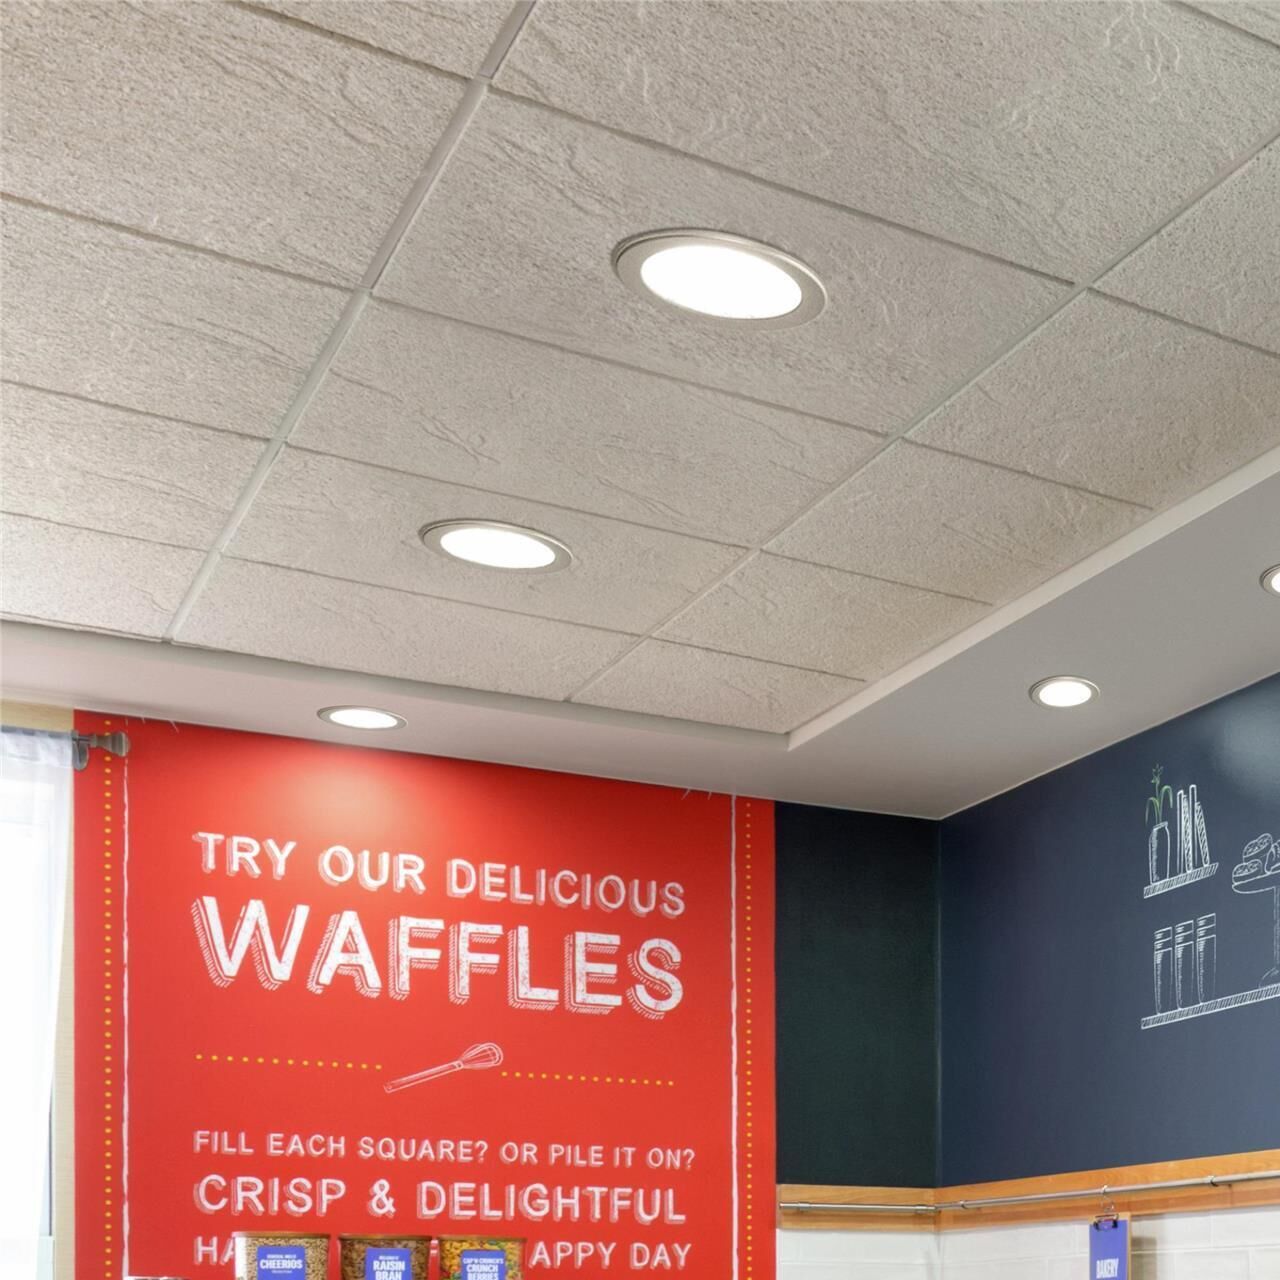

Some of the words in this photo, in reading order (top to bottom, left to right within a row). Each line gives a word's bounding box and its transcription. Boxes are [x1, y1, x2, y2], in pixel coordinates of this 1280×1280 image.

[192, 832, 296, 880] TRY
[318, 845, 426, 894] OUR
[446, 858, 685, 918] DELICIOUS
[191, 896, 683, 1019] WAFFLES
[193, 1130, 254, 1154] FILL
[266, 1133, 345, 1156] EACH
[358, 1136, 488, 1163] SQUARE?
[501, 1142, 538, 1163] OR
[549, 1144, 604, 1167] PILE
[613, 1147, 636, 1167] IT
[646, 1148, 695, 1170] ON?
[193, 1174, 346, 1216] CRISP
[368, 1179, 396, 1217] &
[416, 1181, 686, 1225] DELIGHTFUL
[260, 1259, 303, 1269] CHEERIOS
[373, 1260, 405, 1271] RAISIN
[529, 1241, 616, 1269] APPY
[630, 1243, 691, 1270] DAY
[375, 1271, 402, 1280] BRAN
[466, 1264, 498, 1272] CRUNCH
[467, 1272, 499, 1280] BERRIES
[1096, 1258, 1119, 1279] BAKERY
